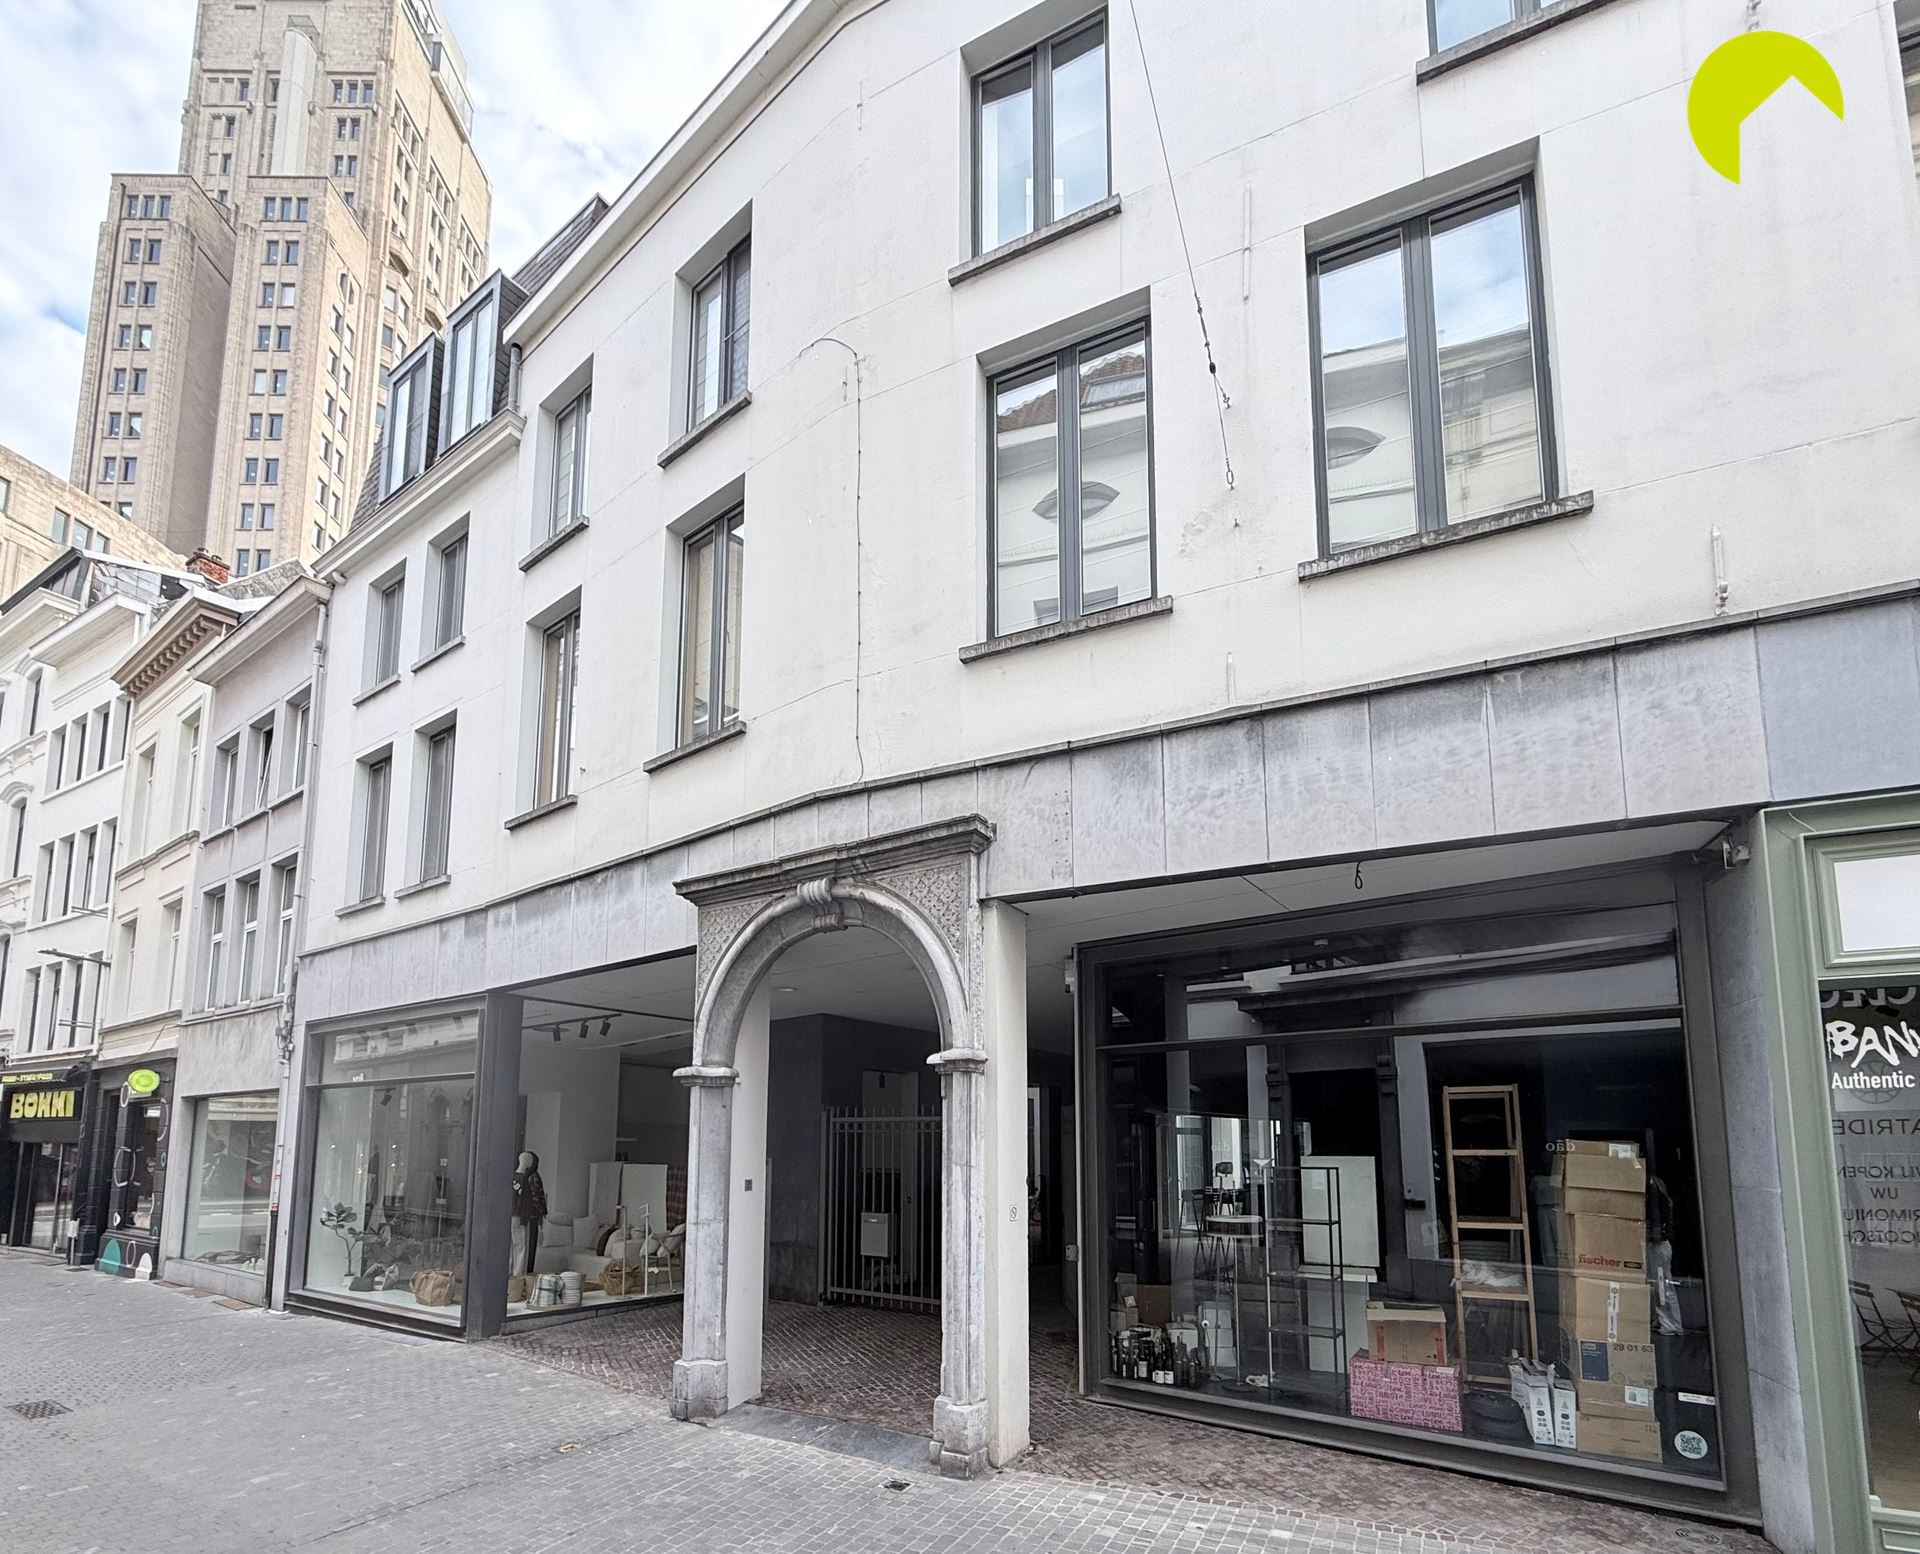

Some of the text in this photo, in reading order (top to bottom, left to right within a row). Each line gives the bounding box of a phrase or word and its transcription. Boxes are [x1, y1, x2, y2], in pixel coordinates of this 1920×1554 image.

[1825, 1020, 1920, 1068] BAN
[1832, 1071, 1916, 1089] Authentic
[1578, 1254, 1622, 1267] fischer
[1613, 1344, 1654, 1353] 29 01 63
